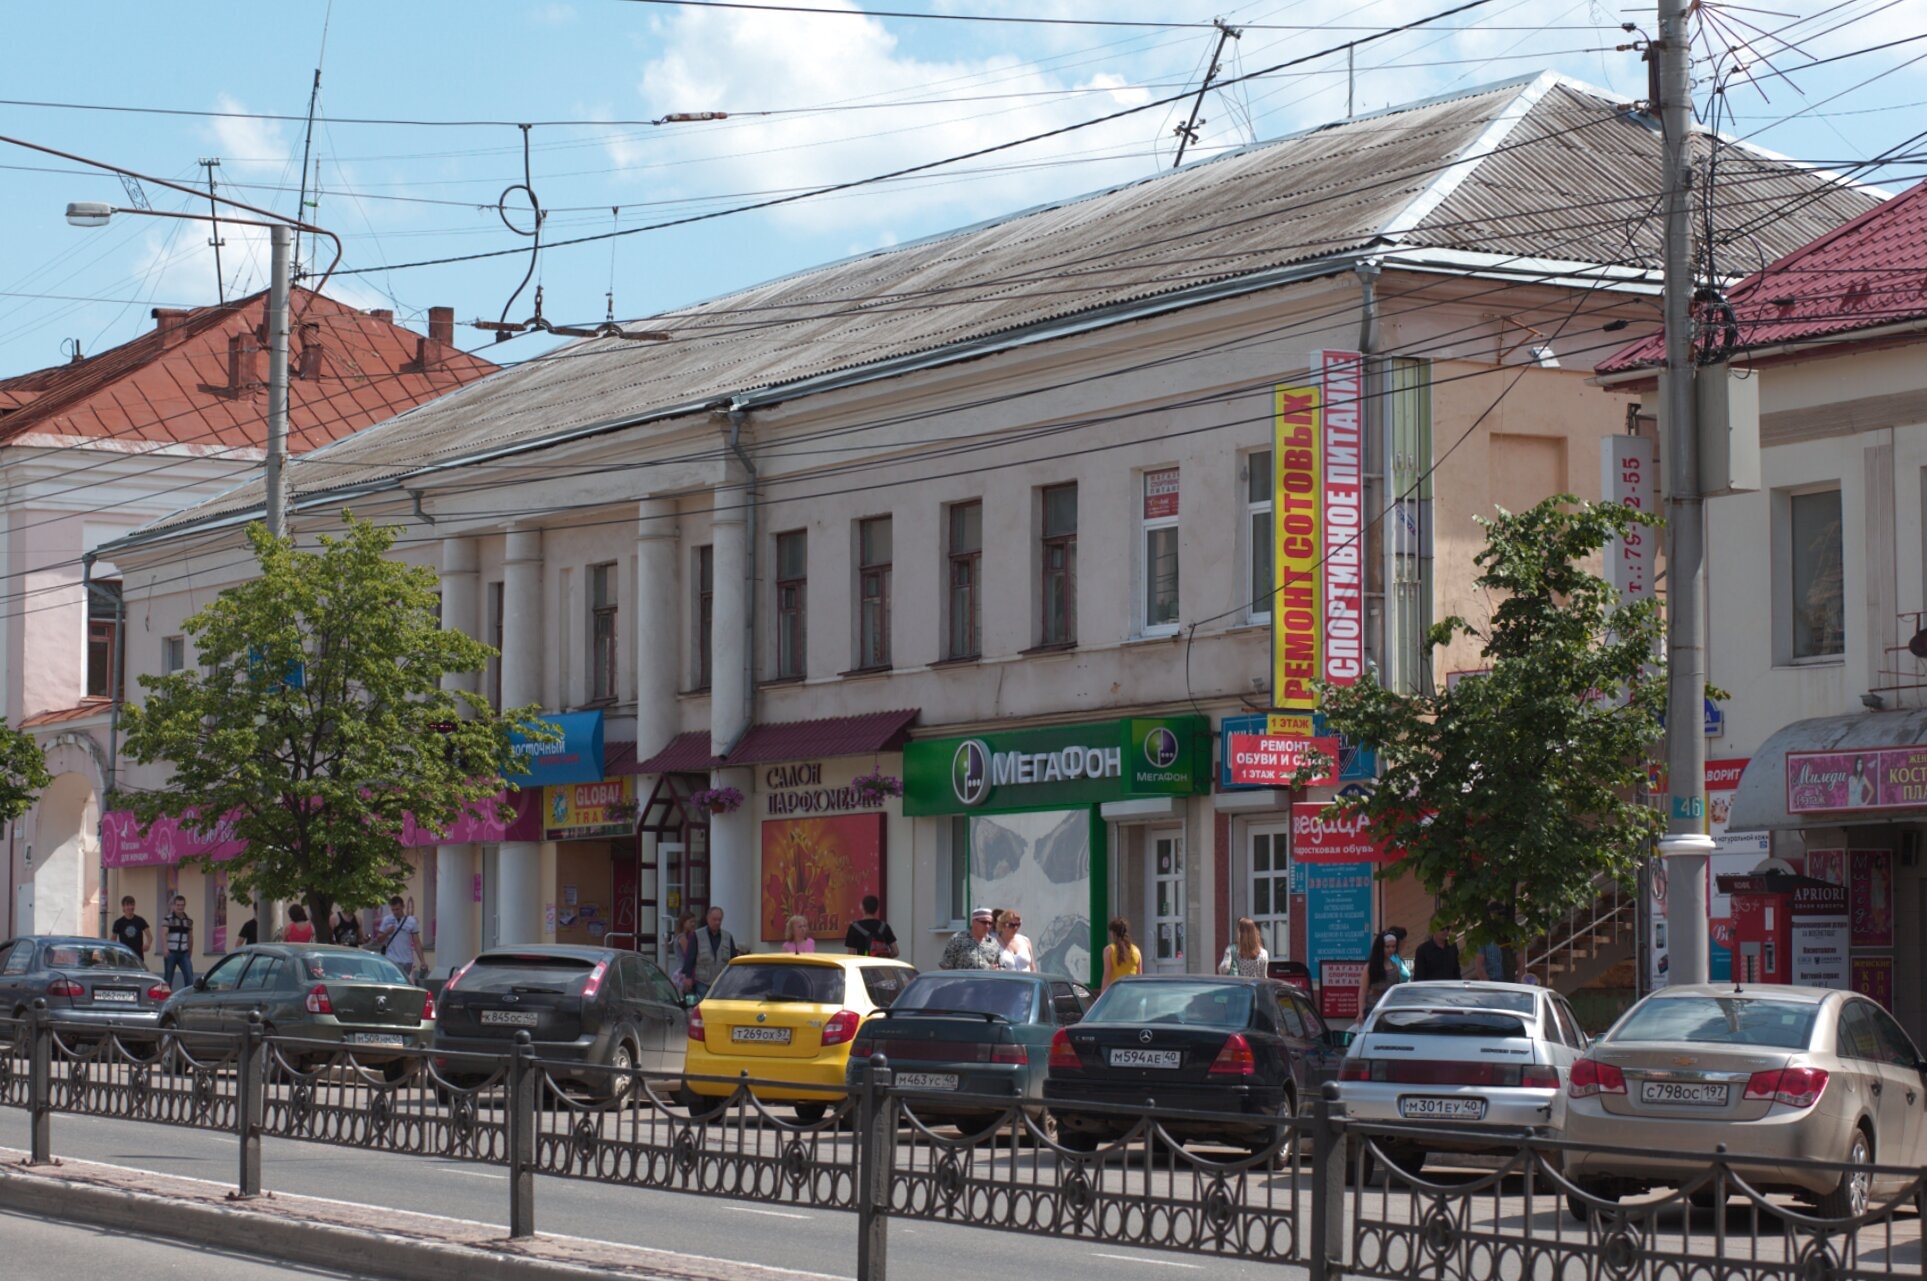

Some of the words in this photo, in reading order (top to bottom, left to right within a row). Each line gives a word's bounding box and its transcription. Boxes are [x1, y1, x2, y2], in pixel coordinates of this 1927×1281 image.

[1327, 356, 1359, 484] ПИТАНИЕ
[1284, 393, 1314, 559] СОТОВЫХ
[1327, 490, 1360, 678] СПОРТИВНОЕ
[1284, 566, 1314, 700] РЕМОНТ
[1271, 718, 1277, 727] 1
[1280, 718, 1309, 729] ЭТАЖ
[1260, 739, 1311, 752] РЕМОНТ
[1236, 752, 1277, 766] ОБУВИ
[1280, 754, 1289, 766] И
[766, 763, 822, 790] САЛОН
[1241, 769, 1247, 778] 1
[1249, 769, 1275, 779] ЭТАЖ
[1793, 762, 1847, 791] Миледи
[1889, 766, 1927, 784] КОСТ
[1680, 797, 1700, 817] 46
[1717, 834, 1754, 844] натуральной
[1343, 844, 1374, 855] обувь
[1794, 887, 1845, 901] APRIORI
[737, 1029, 774, 1040] Т269ОХ
[1113, 1049, 1161, 1064] М594АЕ
[1164, 1051, 1177, 1061] 40
[899, 1074, 942, 1086] М463УС
[945, 1075, 955, 1083] 40
[1647, 1085, 1700, 1099] С798ОС
[1703, 1086, 1724, 1097] 197
[1409, 1098, 1460, 1113] М301ЕУ
[1464, 1100, 1478, 1111] 40
